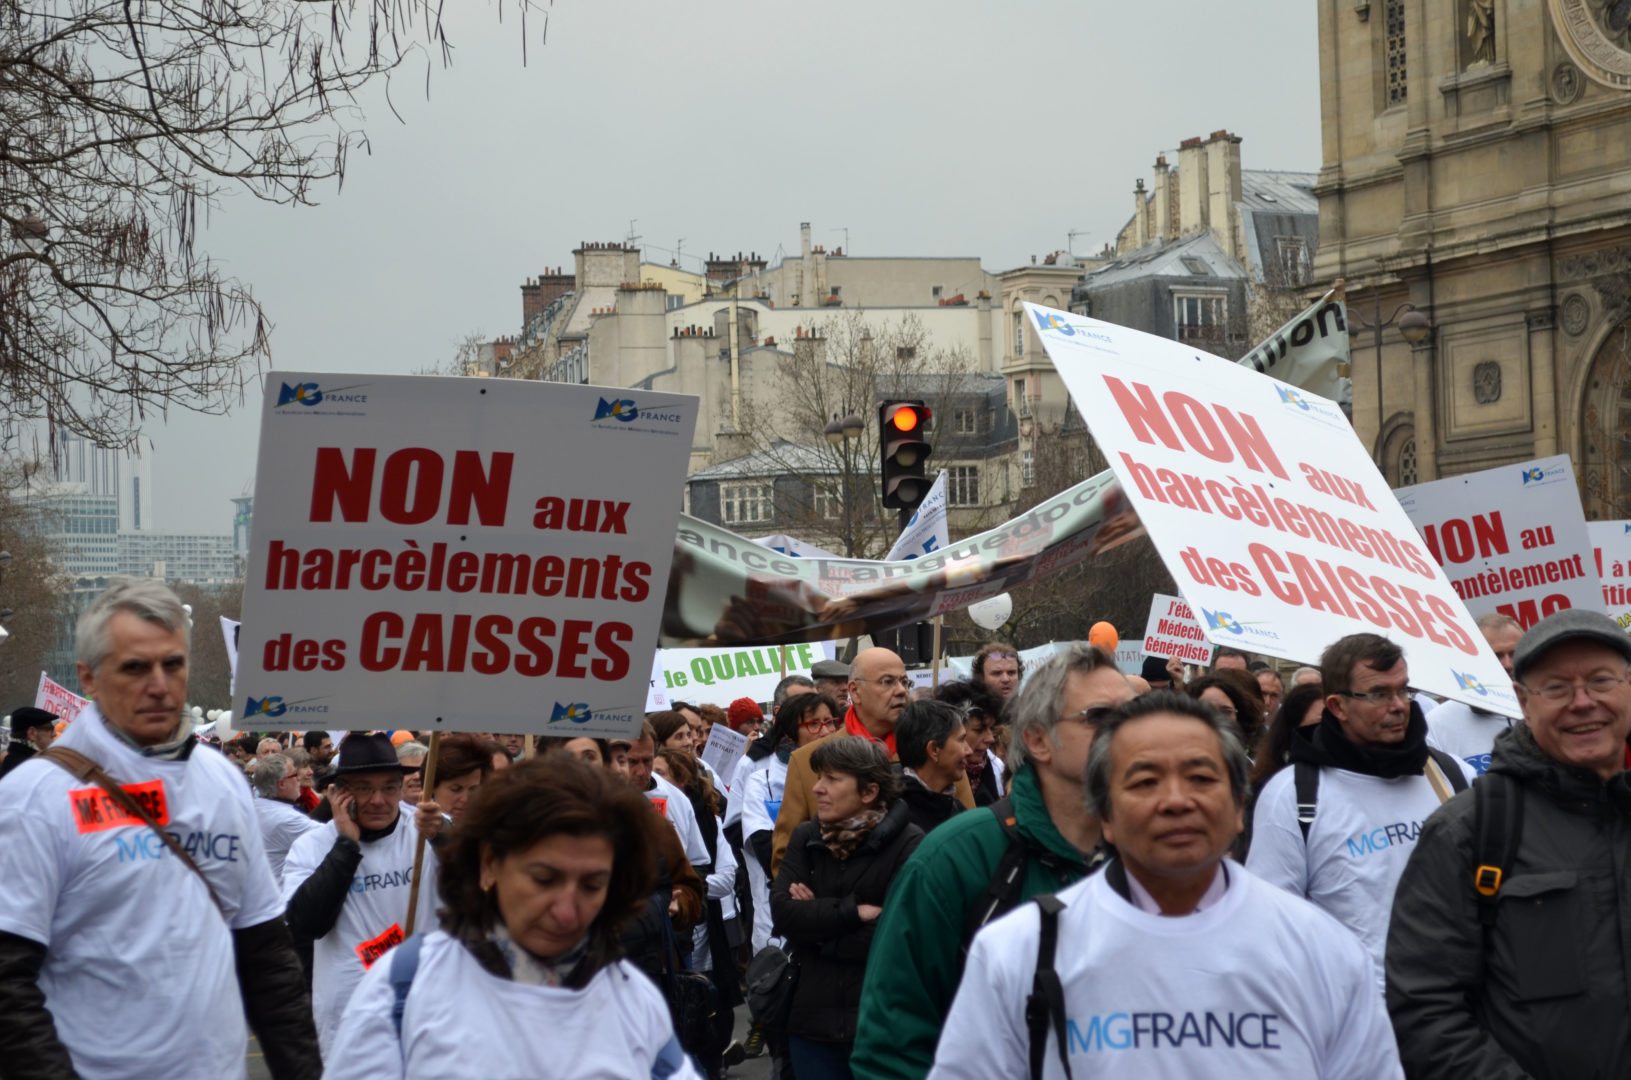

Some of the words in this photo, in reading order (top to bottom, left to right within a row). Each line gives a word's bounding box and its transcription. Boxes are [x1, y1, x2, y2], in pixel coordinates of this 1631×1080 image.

[277, 381, 322, 406] MG
[325, 394, 368, 403] FRANCE
[593, 396, 638, 422] MG
[640, 411, 681, 423] FRANCE
[1101, 374, 1291, 482] NON
[1299, 462, 1378, 512] aux
[309, 447, 514, 526] NON
[533, 496, 631, 534] aux
[1118, 450, 1436, 581] harcèlements
[1520, 525, 1555, 549] au
[265, 540, 652, 602] harcèlements
[1452, 553, 1586, 601] antèlement
[1179, 546, 1262, 597] des
[1248, 542, 1479, 656] CAISSES
[262, 633, 346, 671] des
[359, 611, 633, 681] CAISSES
[1145, 635, 1209, 662] Généraliste
[243, 695, 287, 718] MG
[289, 705, 328, 713] FRANCE
[548, 701, 592, 723] MG
[594, 713, 632, 722] FRANCE
[1346, 820, 1424, 858] MGFRA
[1066, 1012, 1281, 1055] MGFRANCE
